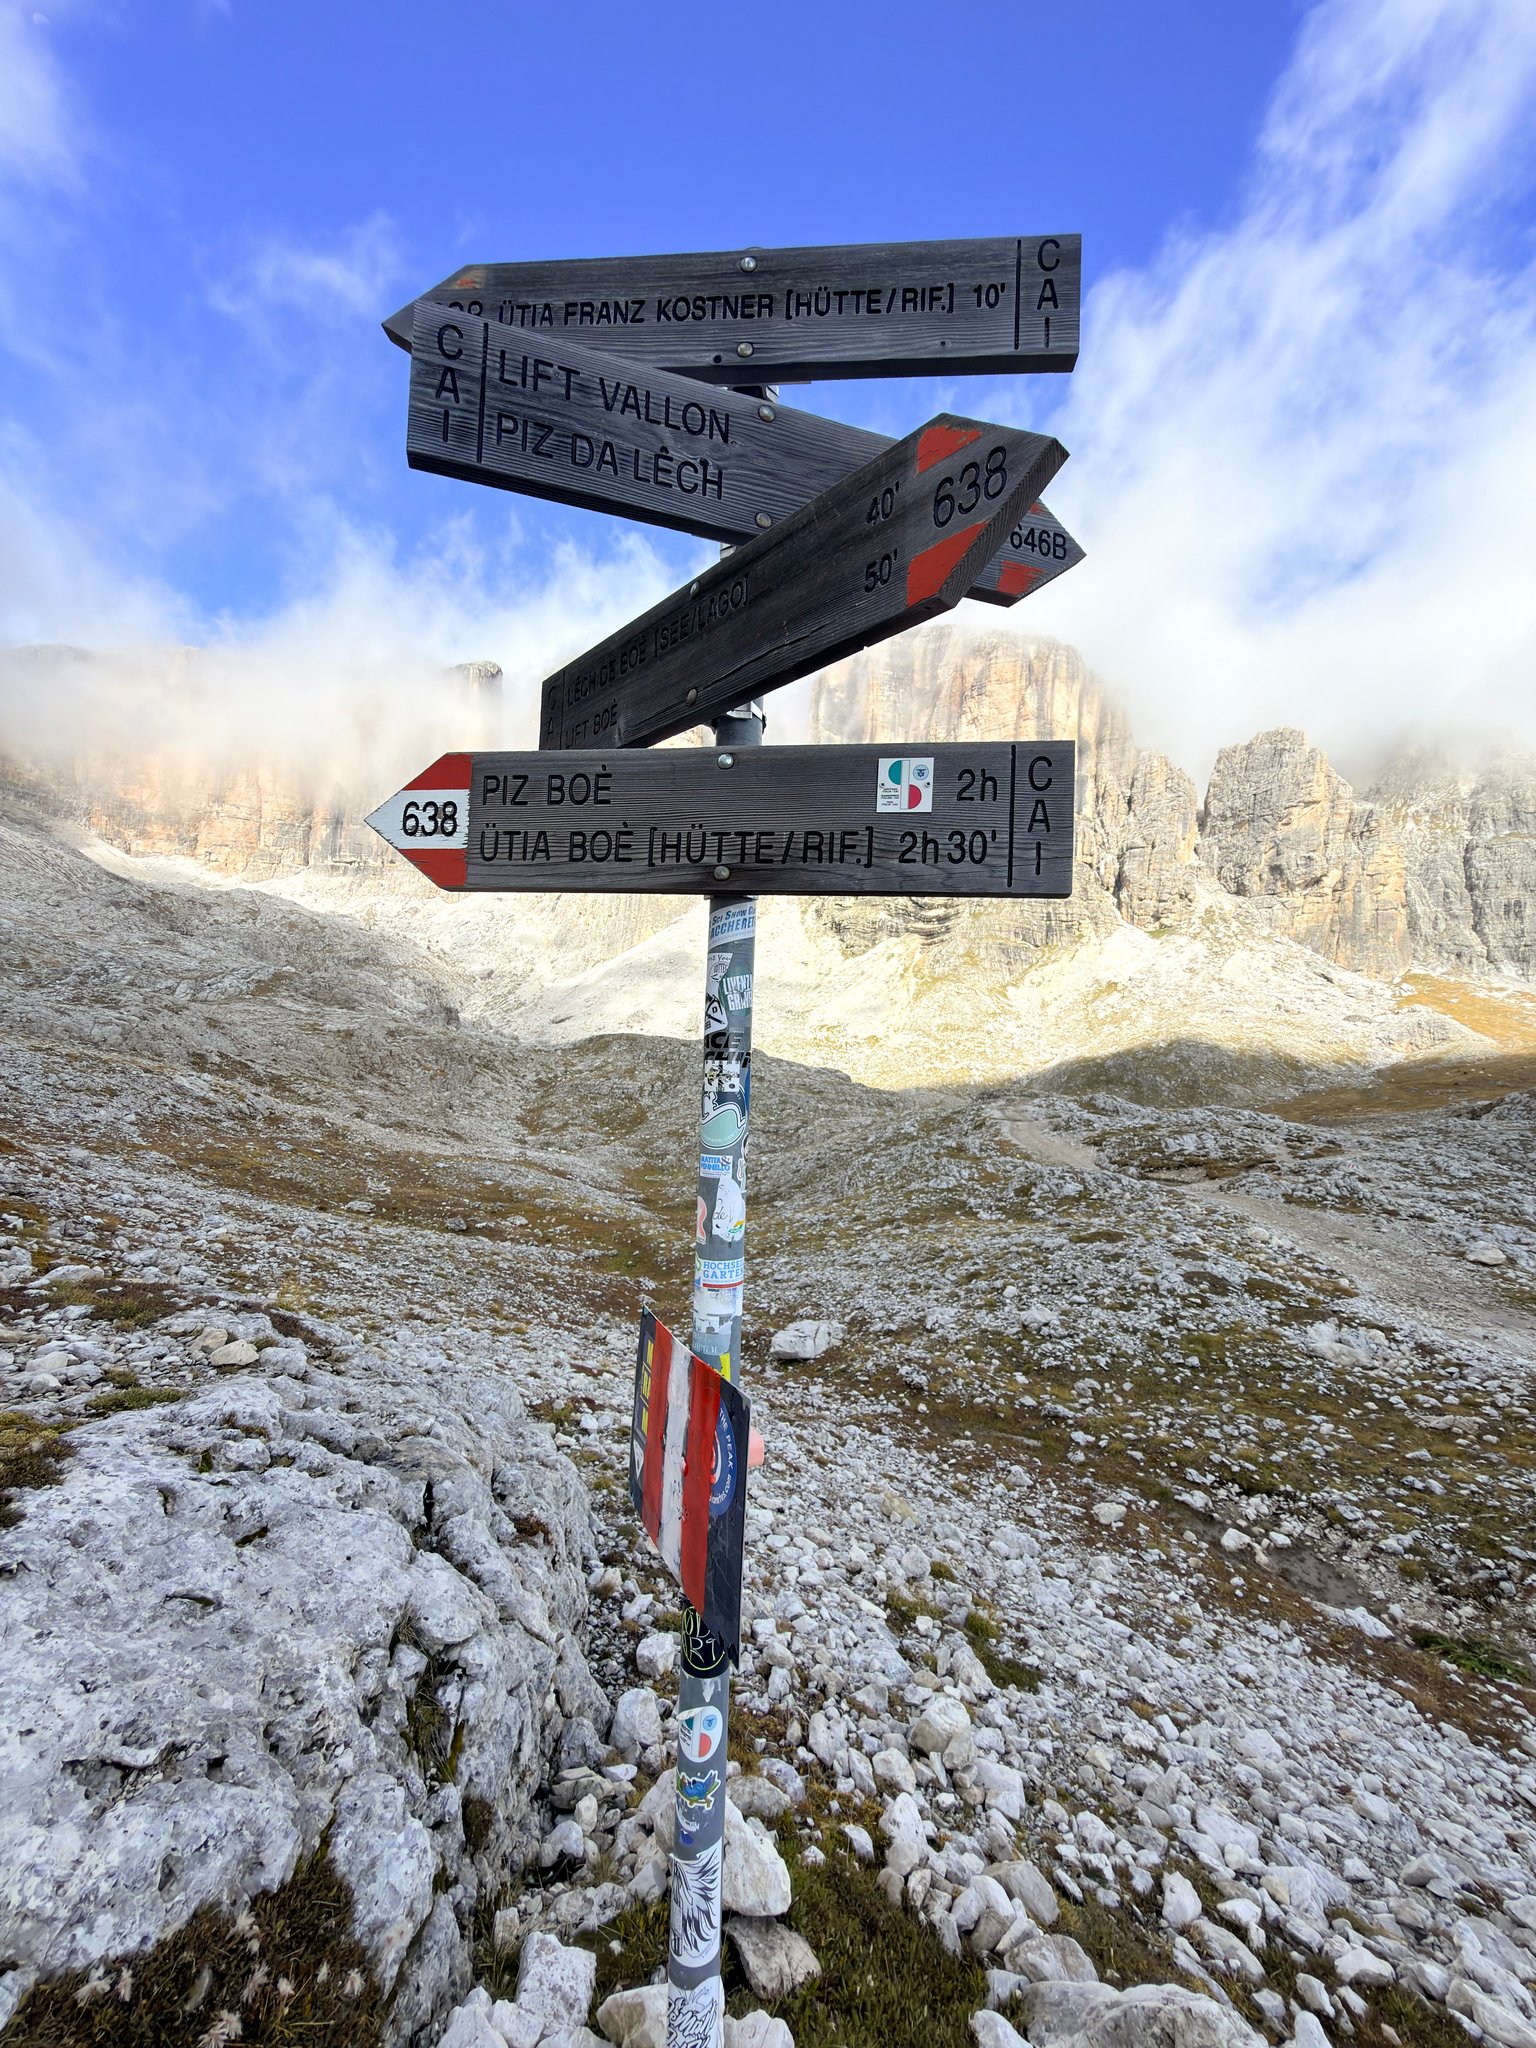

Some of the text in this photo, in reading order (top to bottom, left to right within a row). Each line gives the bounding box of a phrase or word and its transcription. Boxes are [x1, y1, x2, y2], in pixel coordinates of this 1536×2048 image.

[499, 300, 554, 328] ÜTIA
[563, 299, 646, 326] FRANZ
[656, 294, 774, 322] KOSTNER
[785, 284, 955, 321] [HÜTTE/RIF.]
[973, 283, 1006, 310] 10'
[499, 350, 731, 444] LIFT VALLON
[496, 412, 555, 459] PIZ
[571, 434, 619, 476] DA
[932, 446, 1008, 529] 638
[1009, 522, 1068, 561] 646B
[600, 659, 617, 688] DE
[866, 481, 901, 526] 40'
[564, 720, 590, 750] LIFT
[863, 549, 898, 594] 50'
[482, 774, 530, 806] PIZ
[956, 768, 998, 802] 2h
[402, 800, 458, 838] 638
[480, 822, 551, 863] ÜTIA
[648, 824, 873, 869] [HÜTTE/RIF.]
